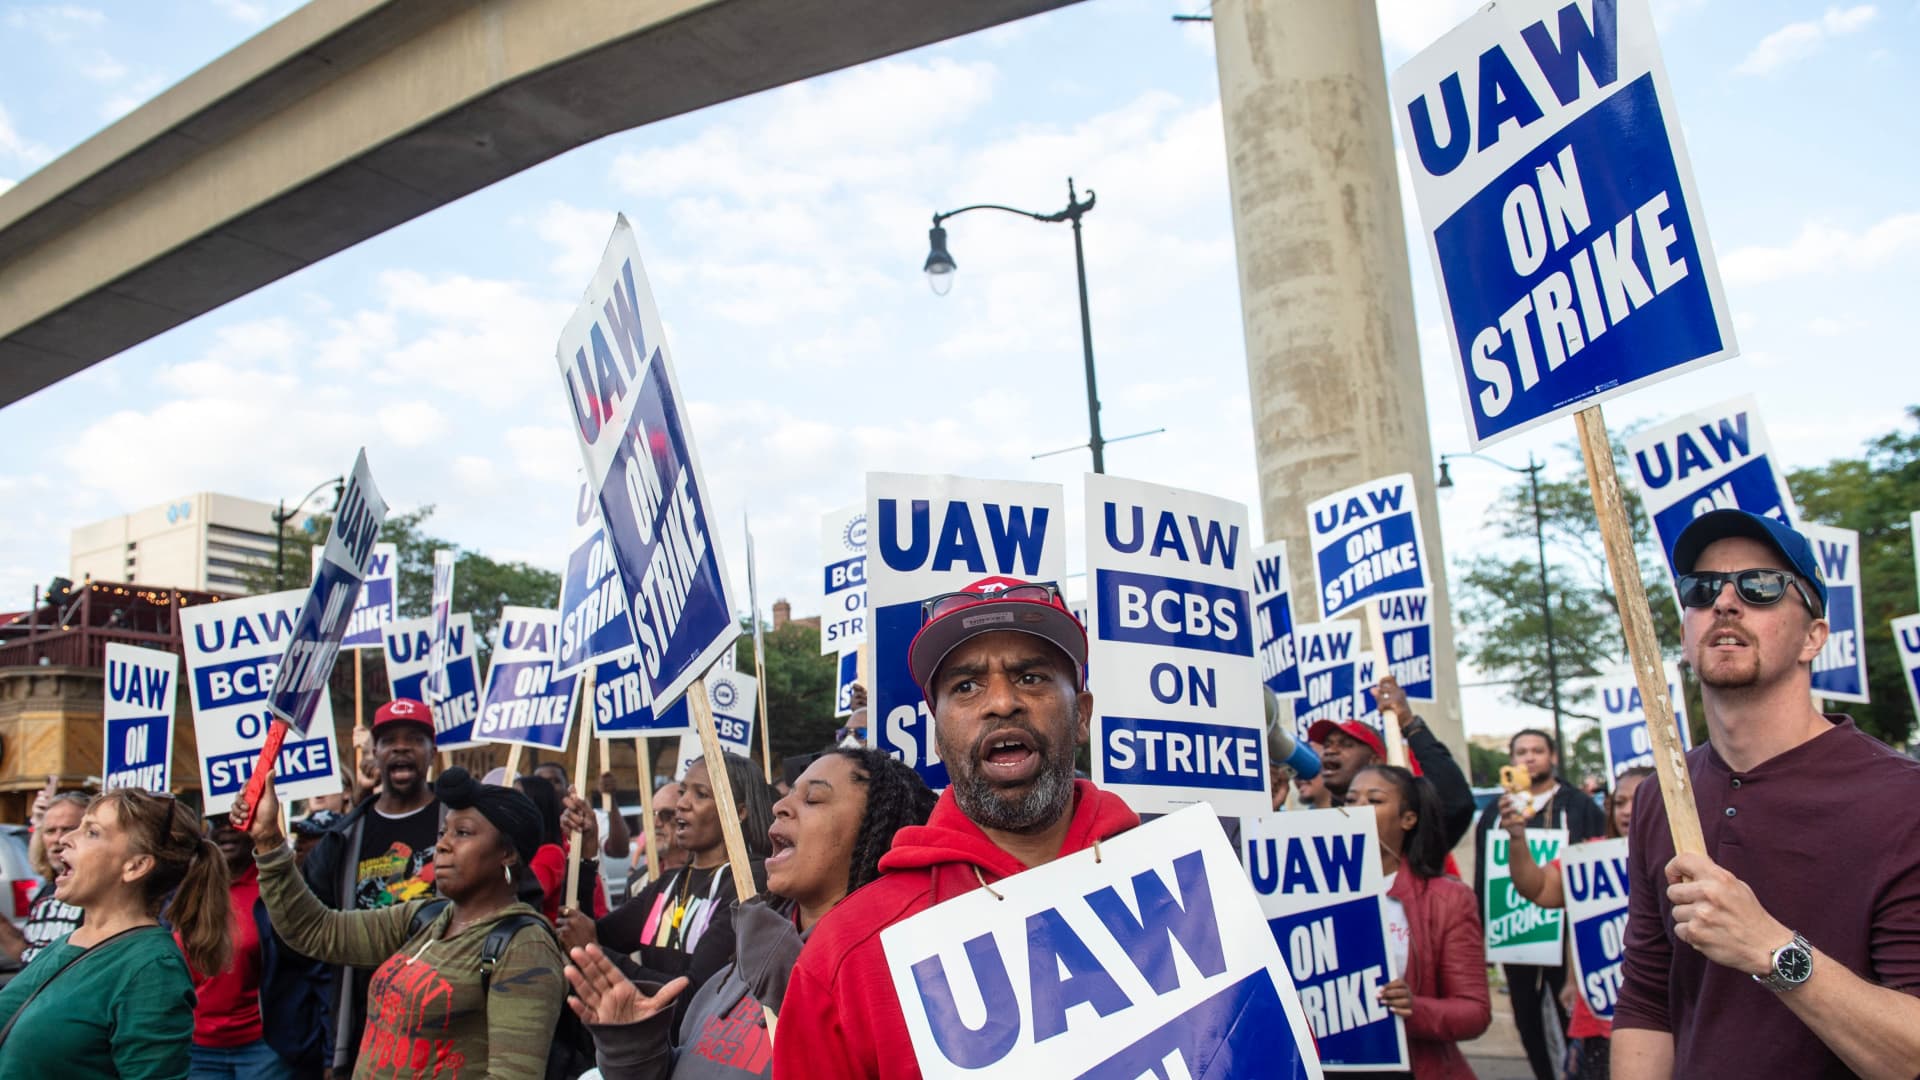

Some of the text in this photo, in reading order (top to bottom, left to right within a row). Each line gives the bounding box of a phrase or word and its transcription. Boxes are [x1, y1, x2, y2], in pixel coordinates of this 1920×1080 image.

[1408, 0, 1618, 177] UAW
[1502, 144, 1591, 277] ON
[1471, 190, 1689, 418] STRIKE
[566, 257, 647, 446] UAW
[1635, 411, 1750, 490] UAW
[625, 418, 664, 546] ON
[337, 475, 378, 572] UAW
[1314, 485, 1403, 534] UAW
[878, 498, 1049, 577] UAW
[1104, 501, 1239, 570] UAW
[1346, 524, 1384, 565] ON
[635, 463, 706, 680] STRIKE
[831, 562, 867, 588] BC
[1325, 541, 1418, 613] STRIKE
[195, 607, 301, 653] UAW
[320, 581, 349, 633] ON
[562, 574, 626, 662] STRIK
[827, 617, 864, 642] STR
[1118, 585, 1238, 641] BCBS
[1258, 606, 1274, 643] N
[1379, 595, 1427, 621] UAW
[1260, 632, 1296, 683] RIKE
[1392, 631, 1413, 661] ON
[109, 659, 170, 711] UAW
[209, 662, 280, 702] BCB
[514, 665, 550, 697] ON
[1149, 662, 1217, 708] ON
[1308, 671, 1333, 707] ON
[1389, 654, 1430, 688] TRIKE
[433, 690, 477, 734] RIKE
[482, 694, 569, 734] STRIKE
[597, 671, 651, 725] STRI
[1603, 684, 1674, 714] UA
[125, 723, 149, 766] ON
[712, 716, 744, 740] CBS
[1631, 726, 1653, 755] O
[211, 743, 327, 788] STIKE
[1108, 728, 1259, 778] STRIKE
[1249, 833, 1366, 895] UAW
[1494, 840, 1559, 866] UW
[1506, 882, 1529, 909] O
[1289, 915, 1339, 982] ON
[1488, 907, 1557, 945] STRIKE
[910, 849, 1227, 1070] UAW
[1296, 964, 1389, 1039] RIKE
